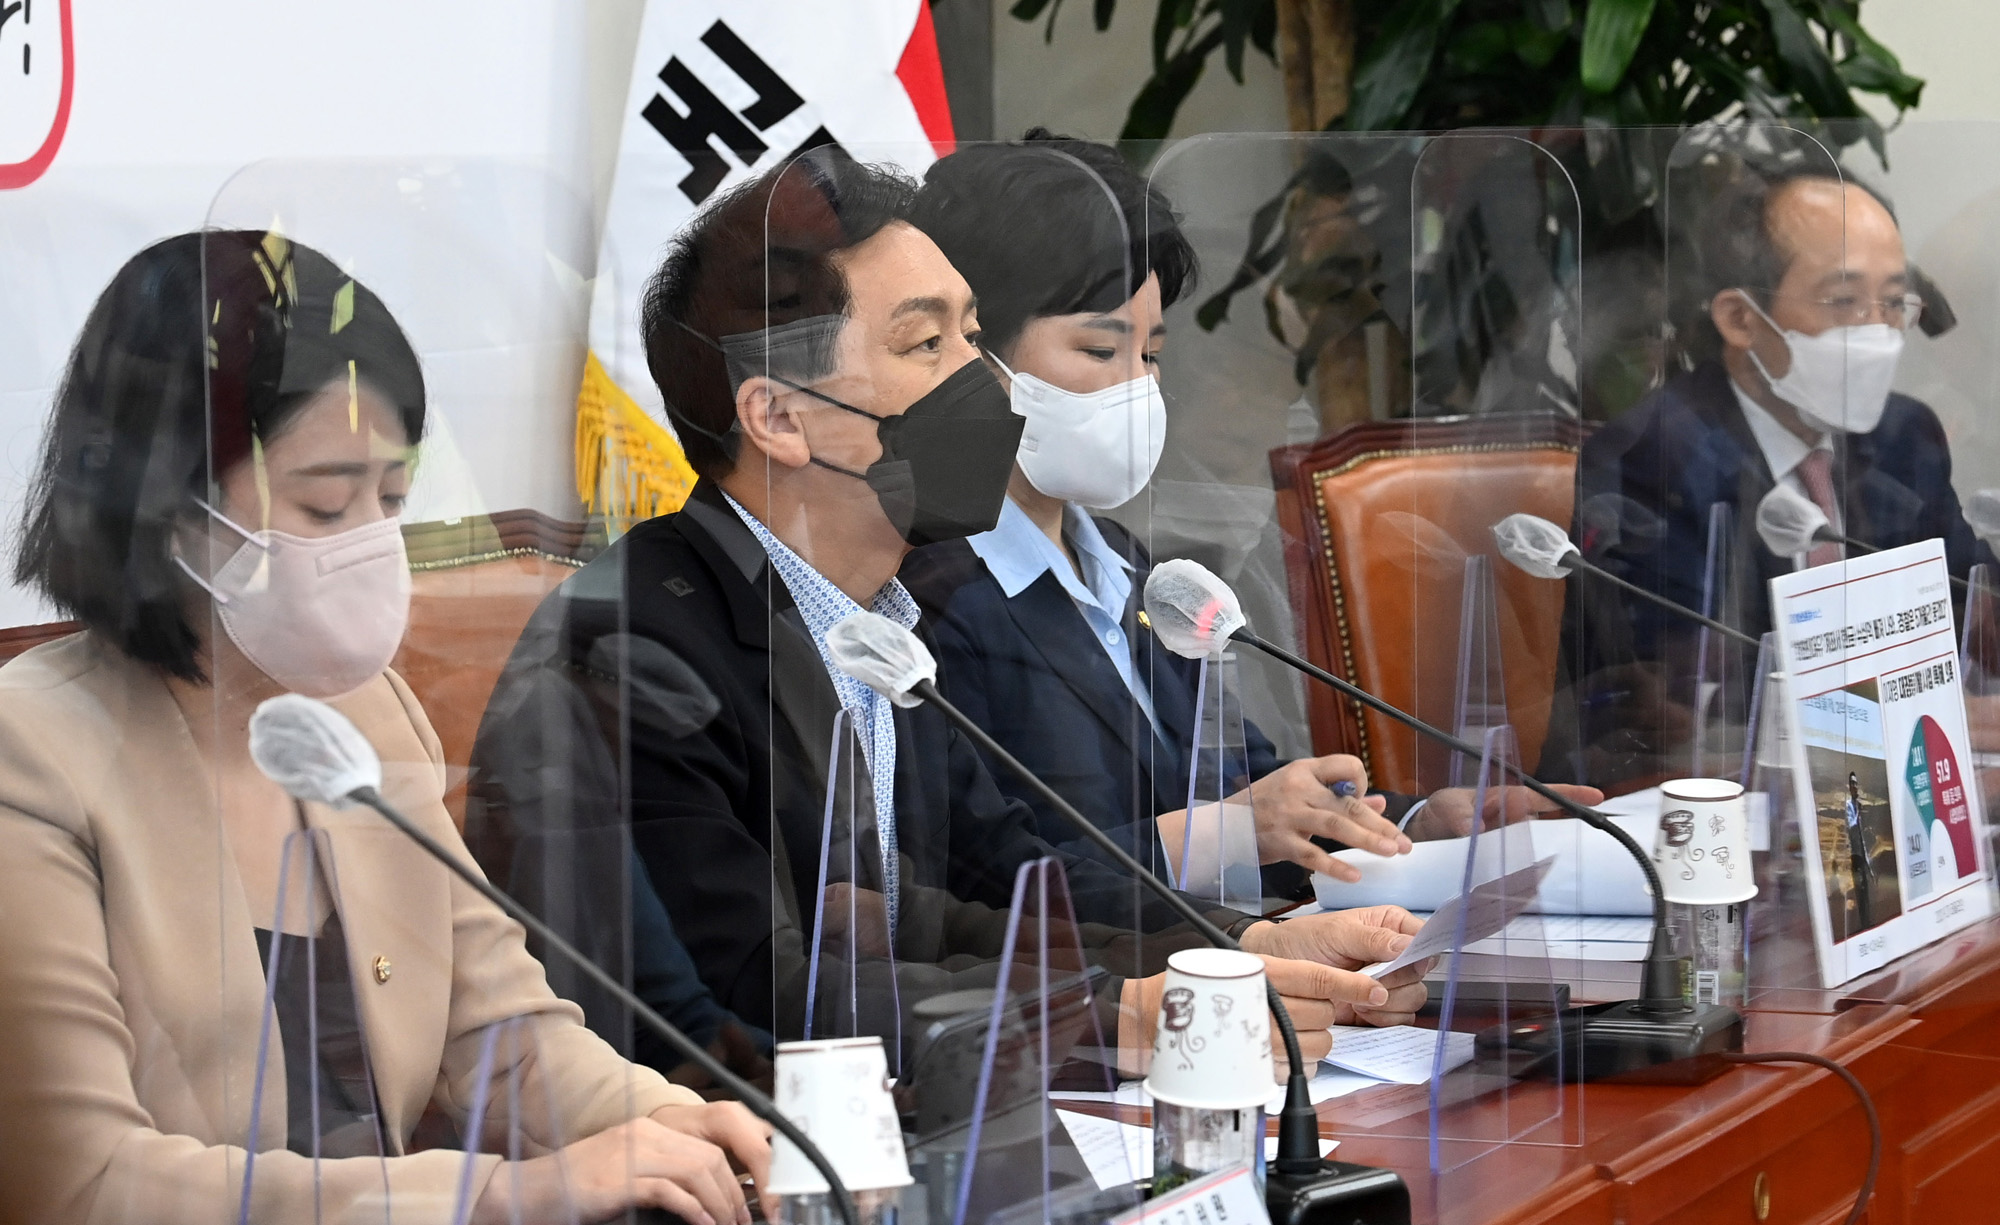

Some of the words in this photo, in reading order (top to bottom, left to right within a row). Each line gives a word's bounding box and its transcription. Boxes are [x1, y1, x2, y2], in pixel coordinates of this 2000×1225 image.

[1932, 663, 1946, 687] 특혜
[1945, 660, 1954, 683] 의혹
[1935, 757, 1951, 784] 51.9
